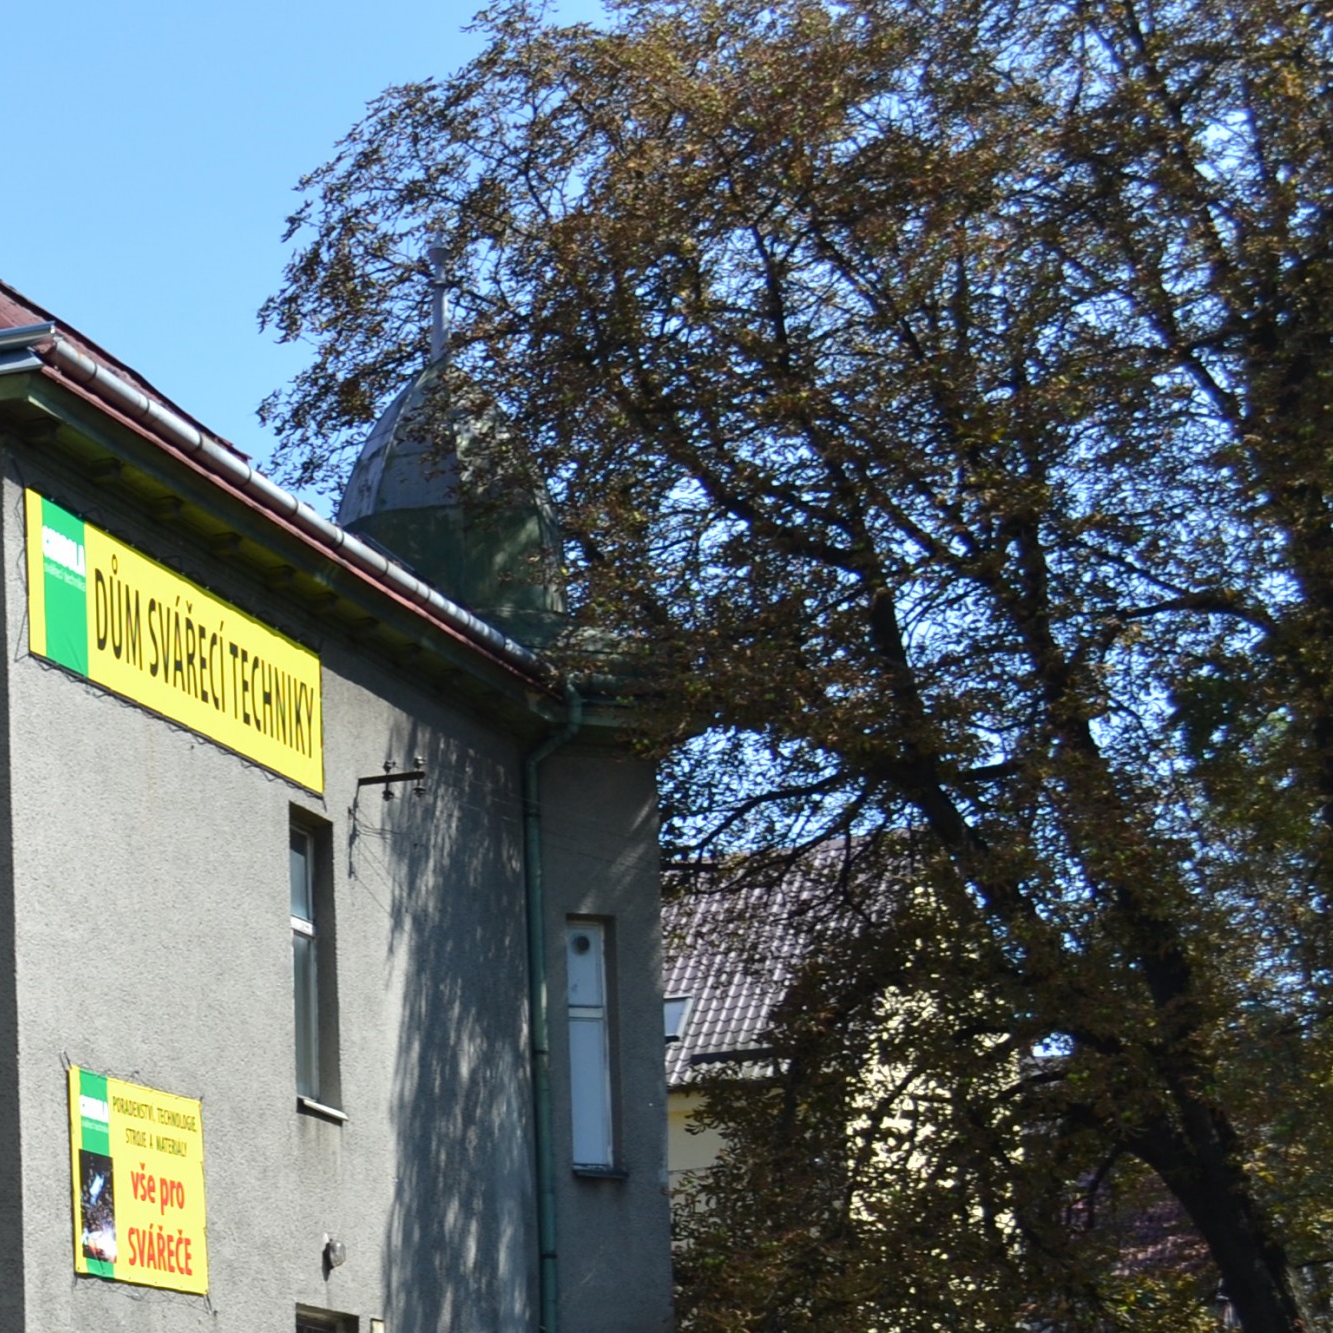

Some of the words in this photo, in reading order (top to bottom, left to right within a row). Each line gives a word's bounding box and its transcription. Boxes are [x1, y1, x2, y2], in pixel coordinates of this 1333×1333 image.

[95, 554, 142, 671] DŮM
[148, 595, 225, 713] SVÁŘECÍ
[229, 641, 314, 758] TECHNIKY
[131, 1162, 156, 1203] vše
[160, 1177, 185, 1216] pro
[128, 1223, 192, 1276] SVÁŘEČE
